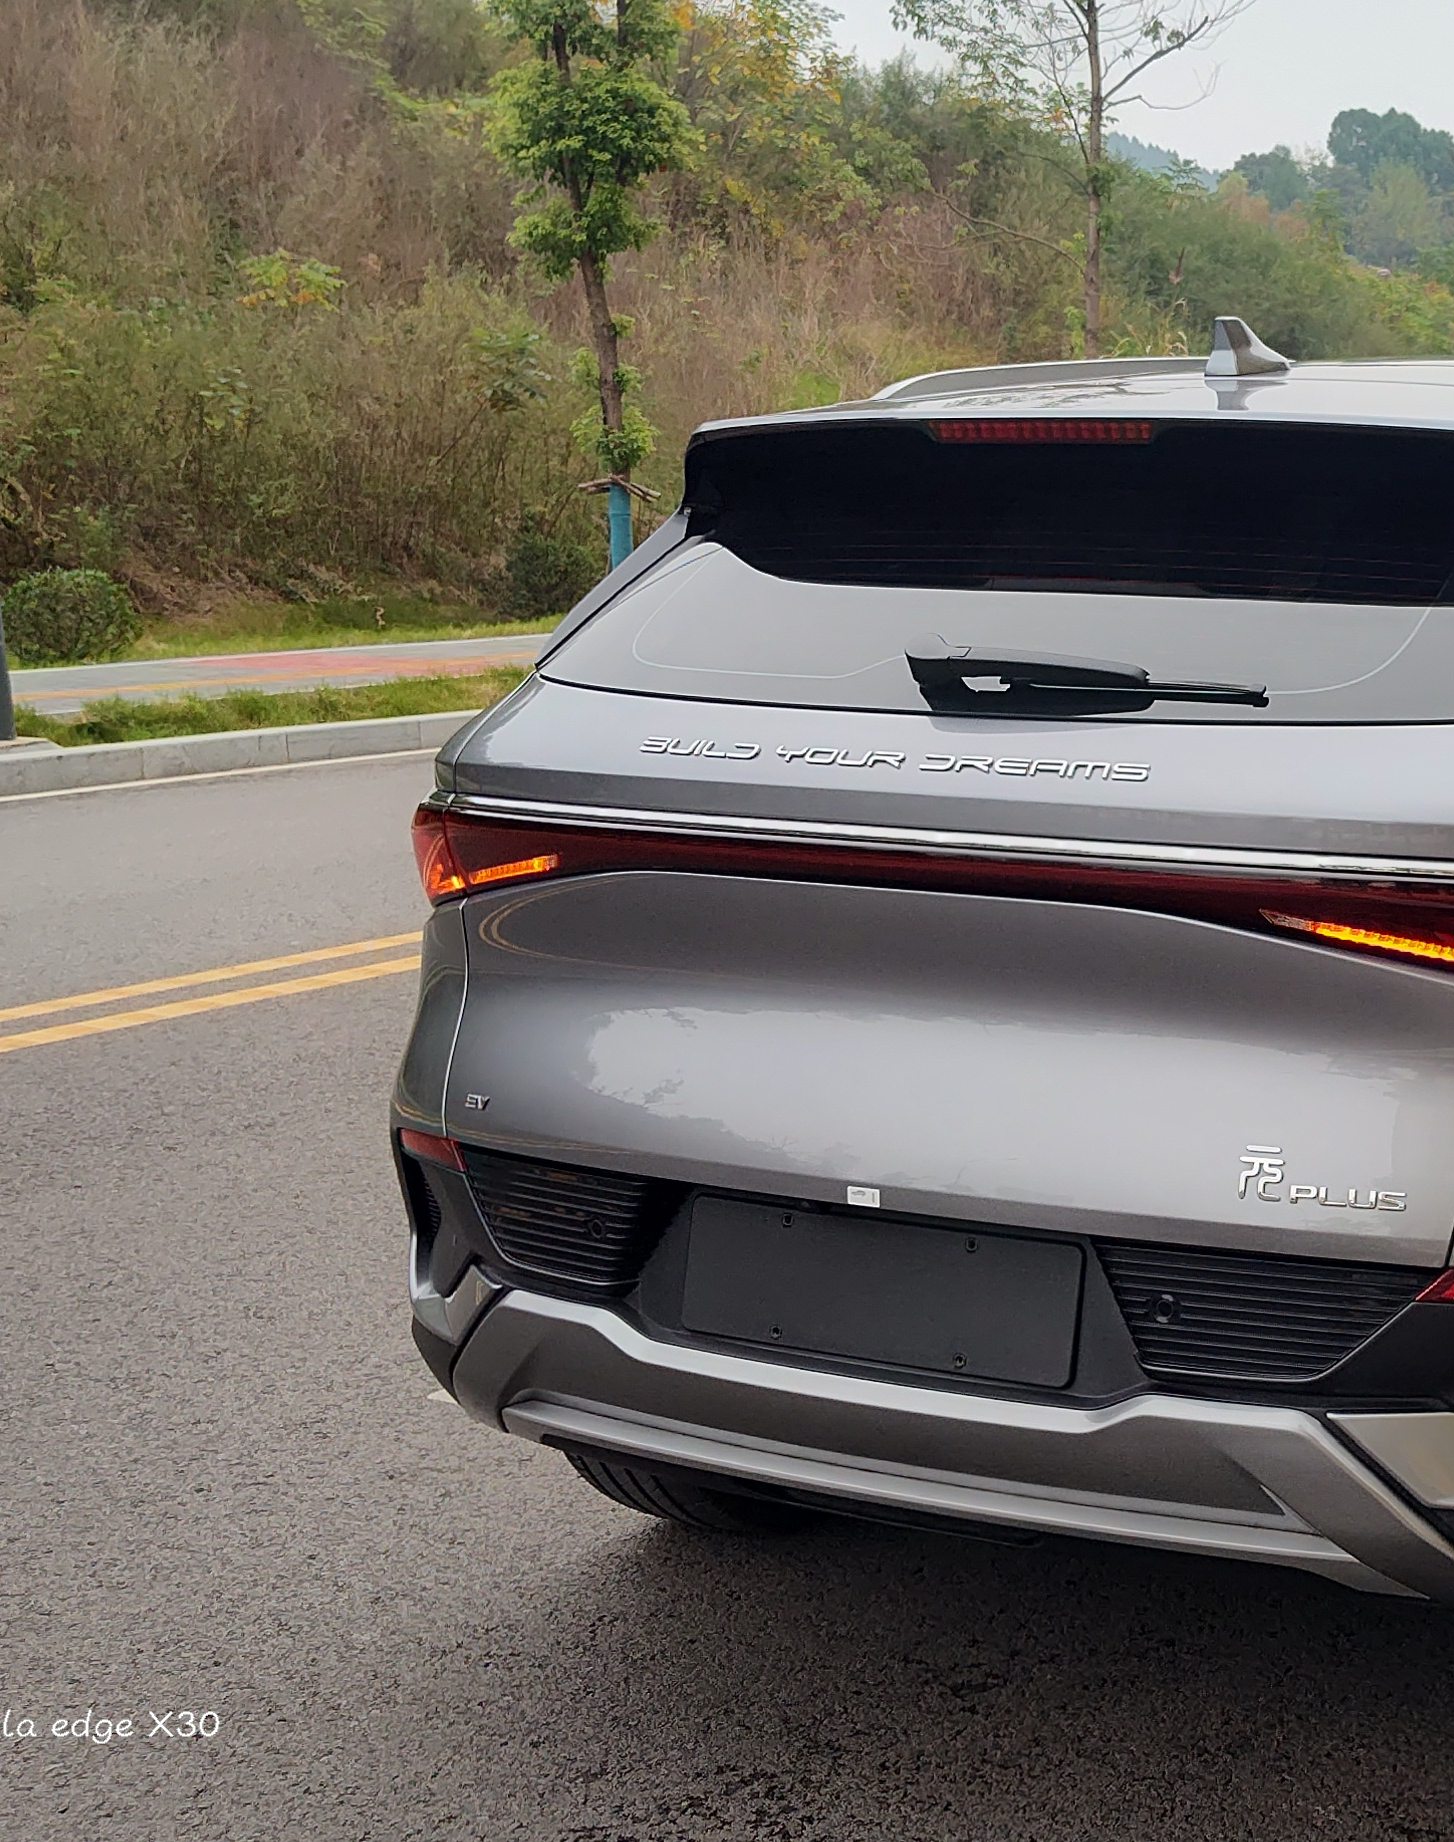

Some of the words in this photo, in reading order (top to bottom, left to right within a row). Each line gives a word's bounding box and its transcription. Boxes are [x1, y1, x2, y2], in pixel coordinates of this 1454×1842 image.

[640, 735, 761, 760] BUILD
[776, 744, 905, 770] YOUR
[918, 753, 1151, 782] DREAMS
[465, 1093, 490, 1111] EV
[1289, 1184, 1407, 1211] PLUS
